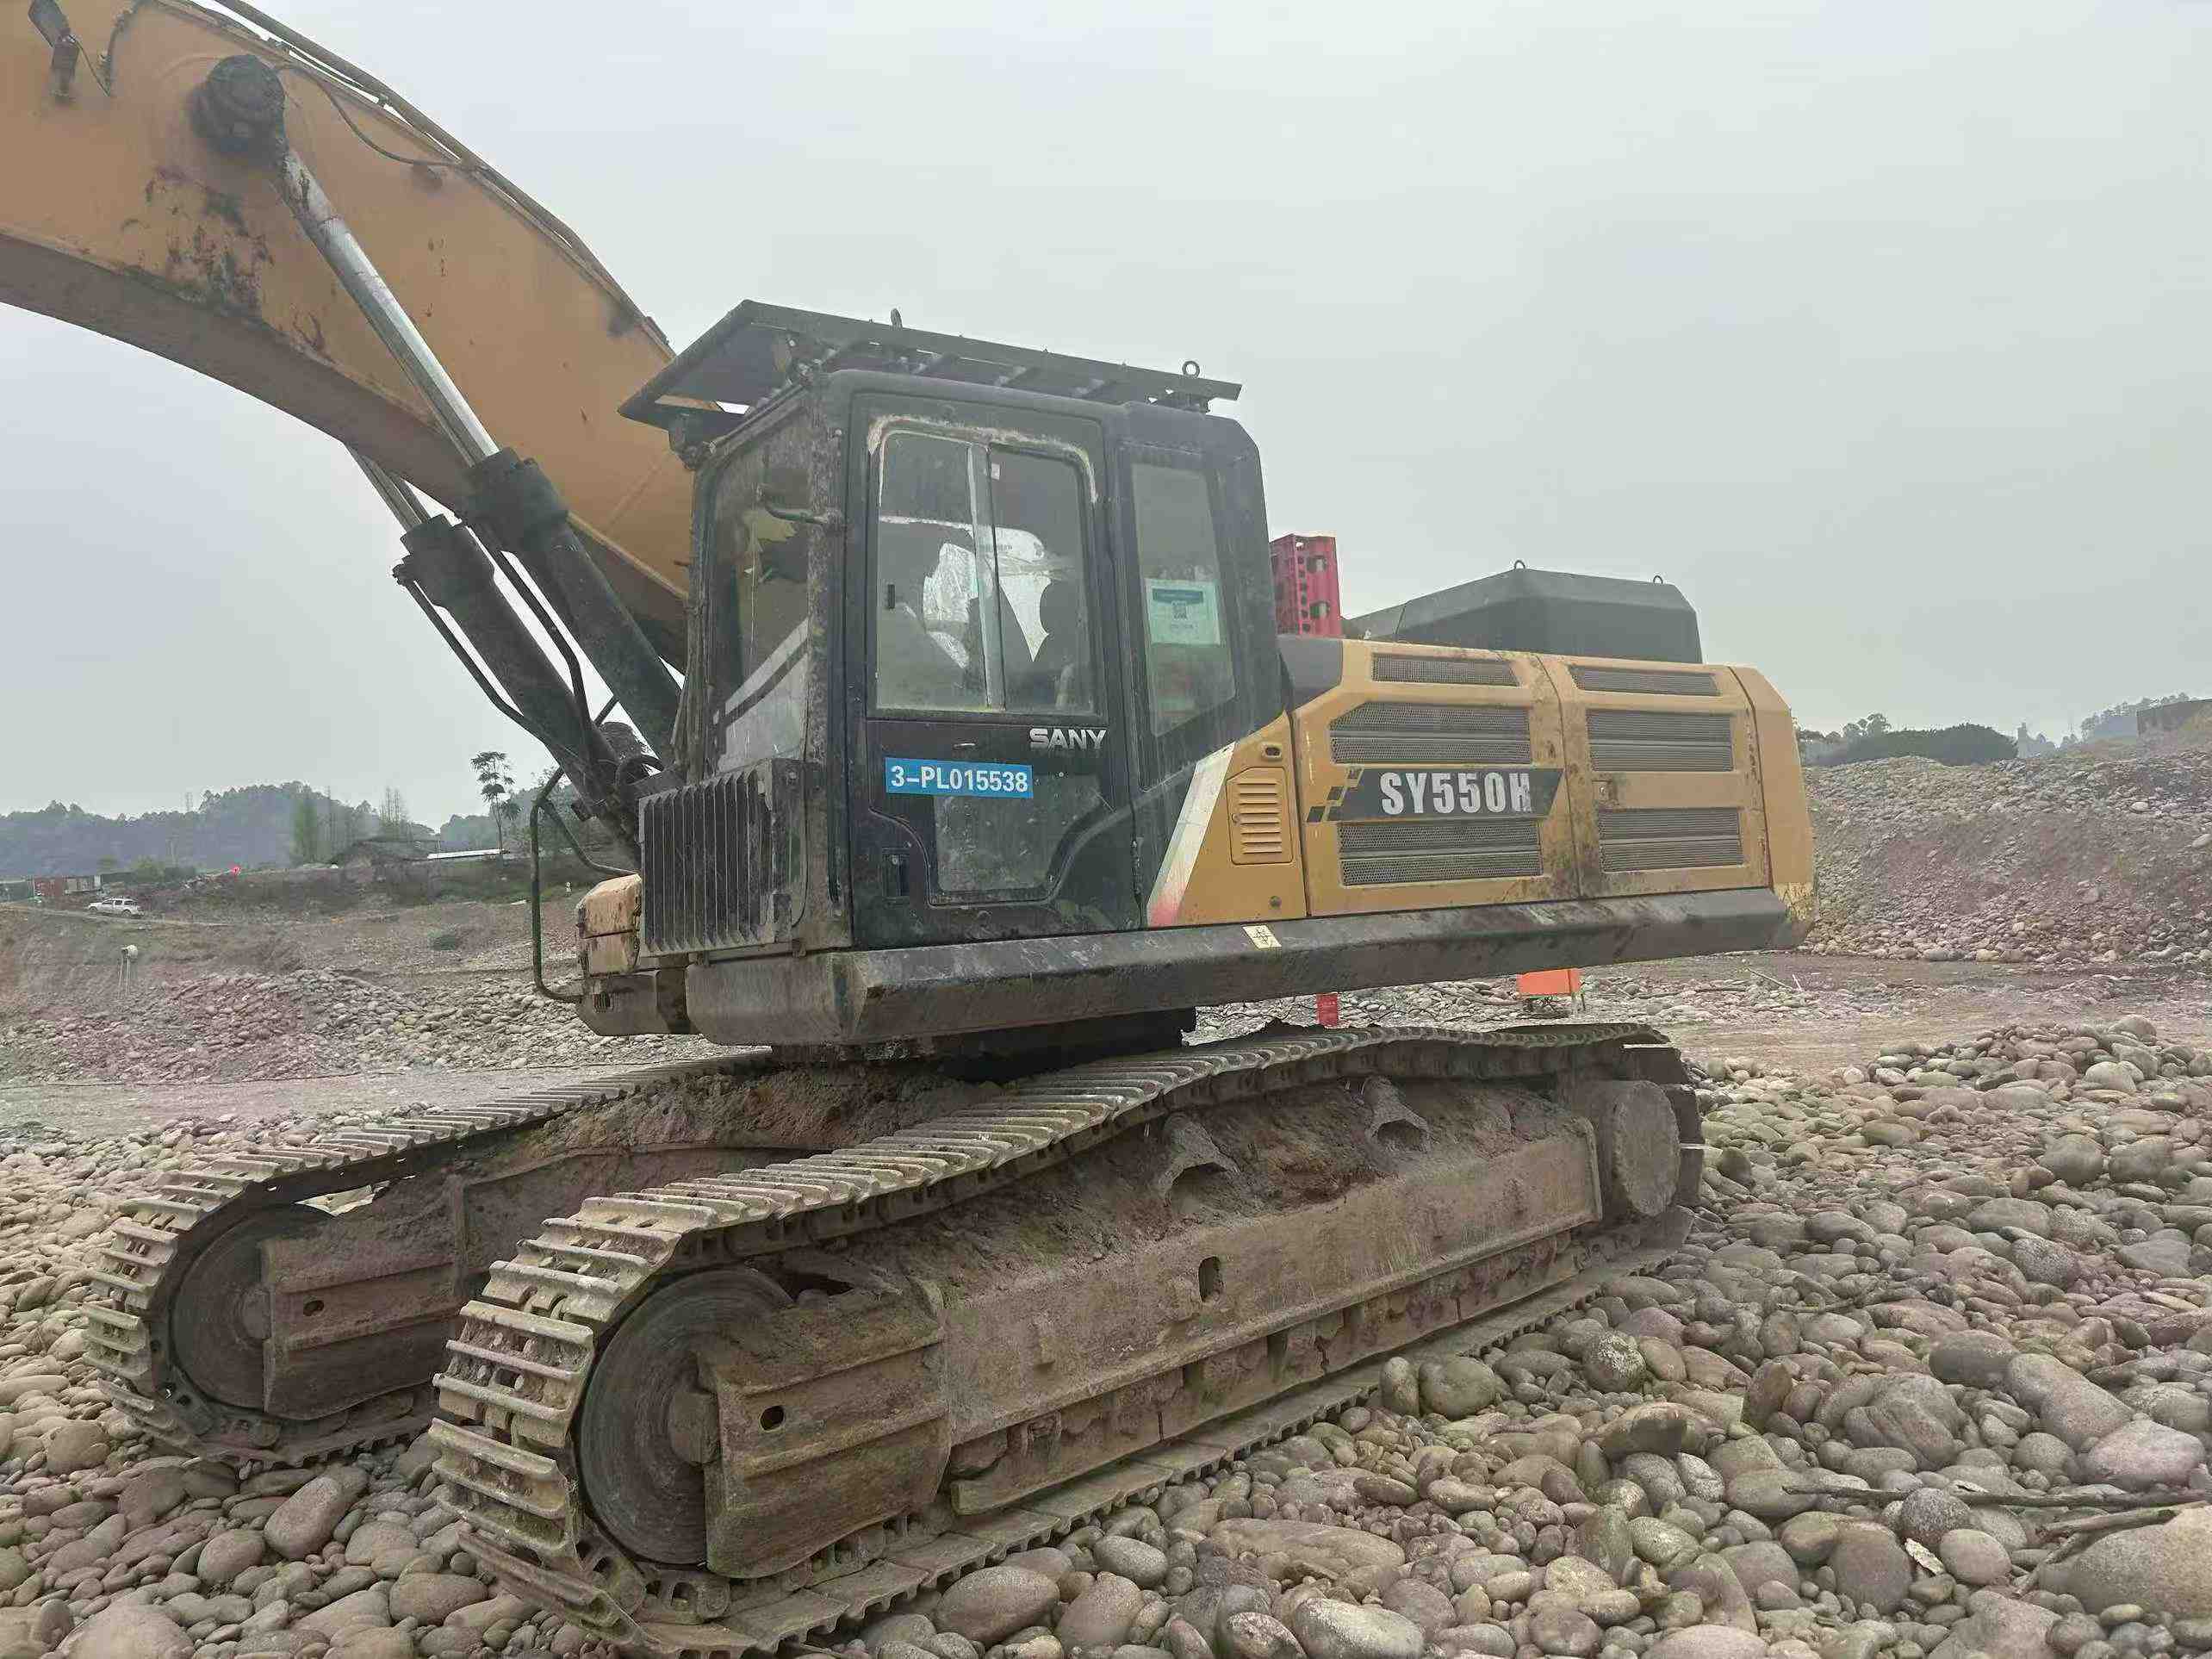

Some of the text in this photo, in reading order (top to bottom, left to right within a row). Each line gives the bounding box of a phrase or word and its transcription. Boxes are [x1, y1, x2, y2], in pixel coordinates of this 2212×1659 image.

[1029, 728, 1107, 749] SANY
[891, 765, 1028, 792] 3-PL015538
[1380, 772, 1532, 815] SY550H
